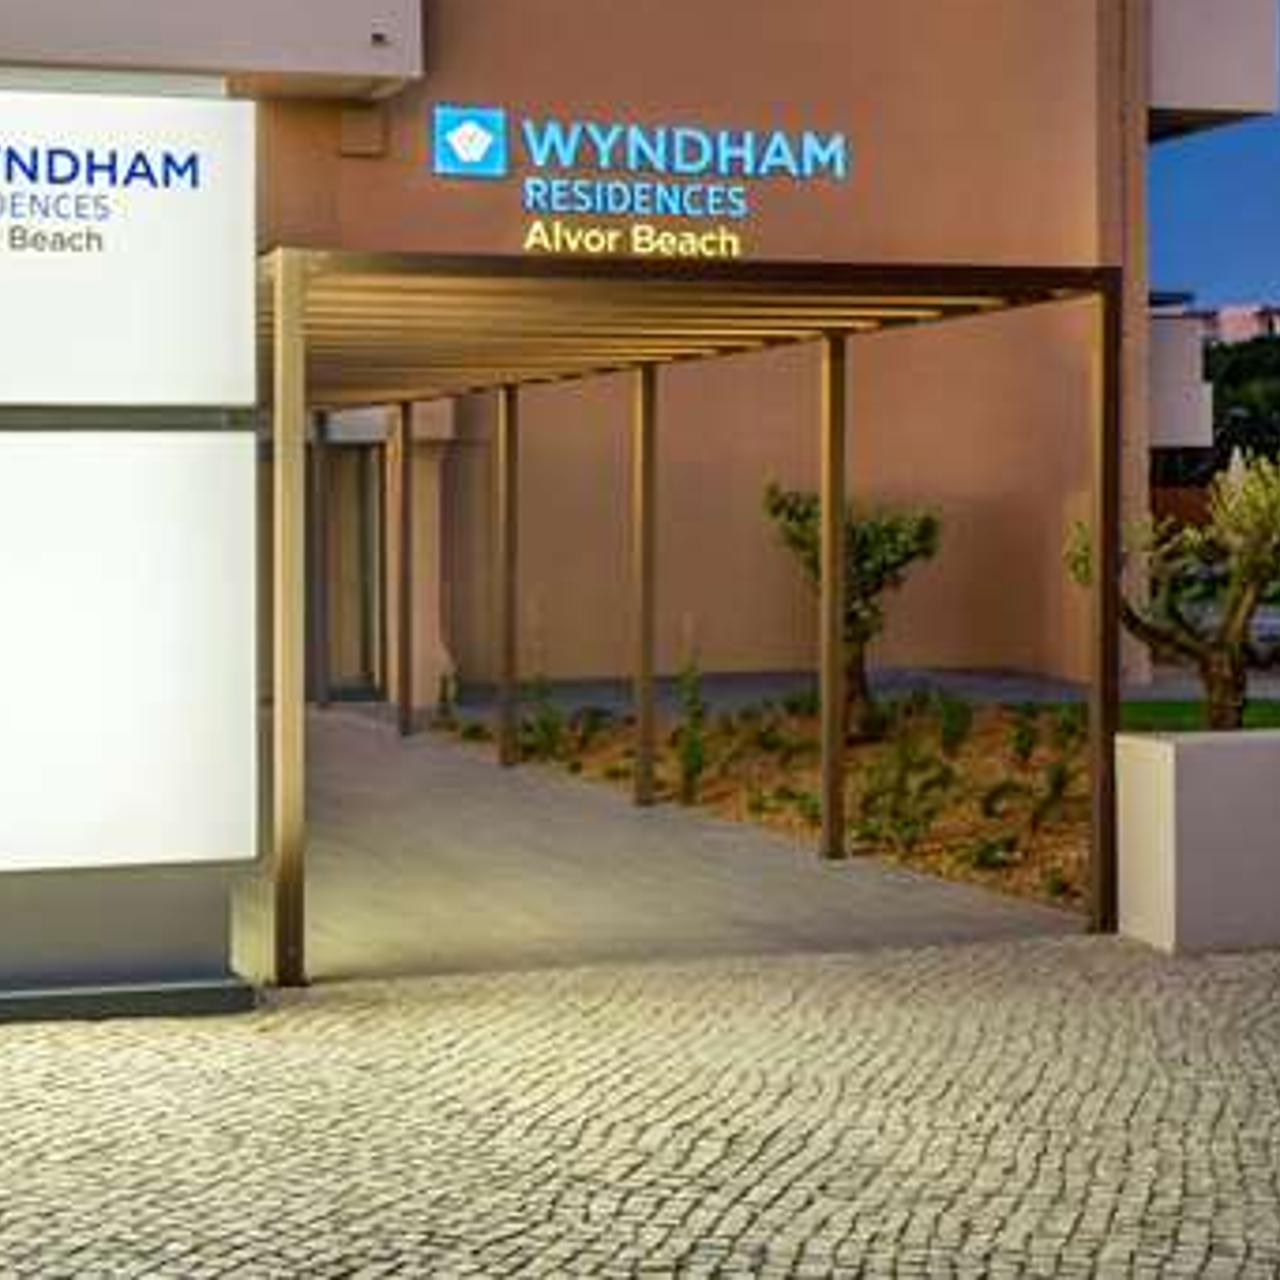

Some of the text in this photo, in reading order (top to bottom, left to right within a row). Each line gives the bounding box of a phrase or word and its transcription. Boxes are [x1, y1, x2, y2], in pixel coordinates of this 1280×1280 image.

[522, 119, 846, 179] WYNDHAM
[524, 179, 749, 217] RESIDENCES
[9, 226, 103, 252] Beach
[524, 221, 740, 258] Alvor Beach
